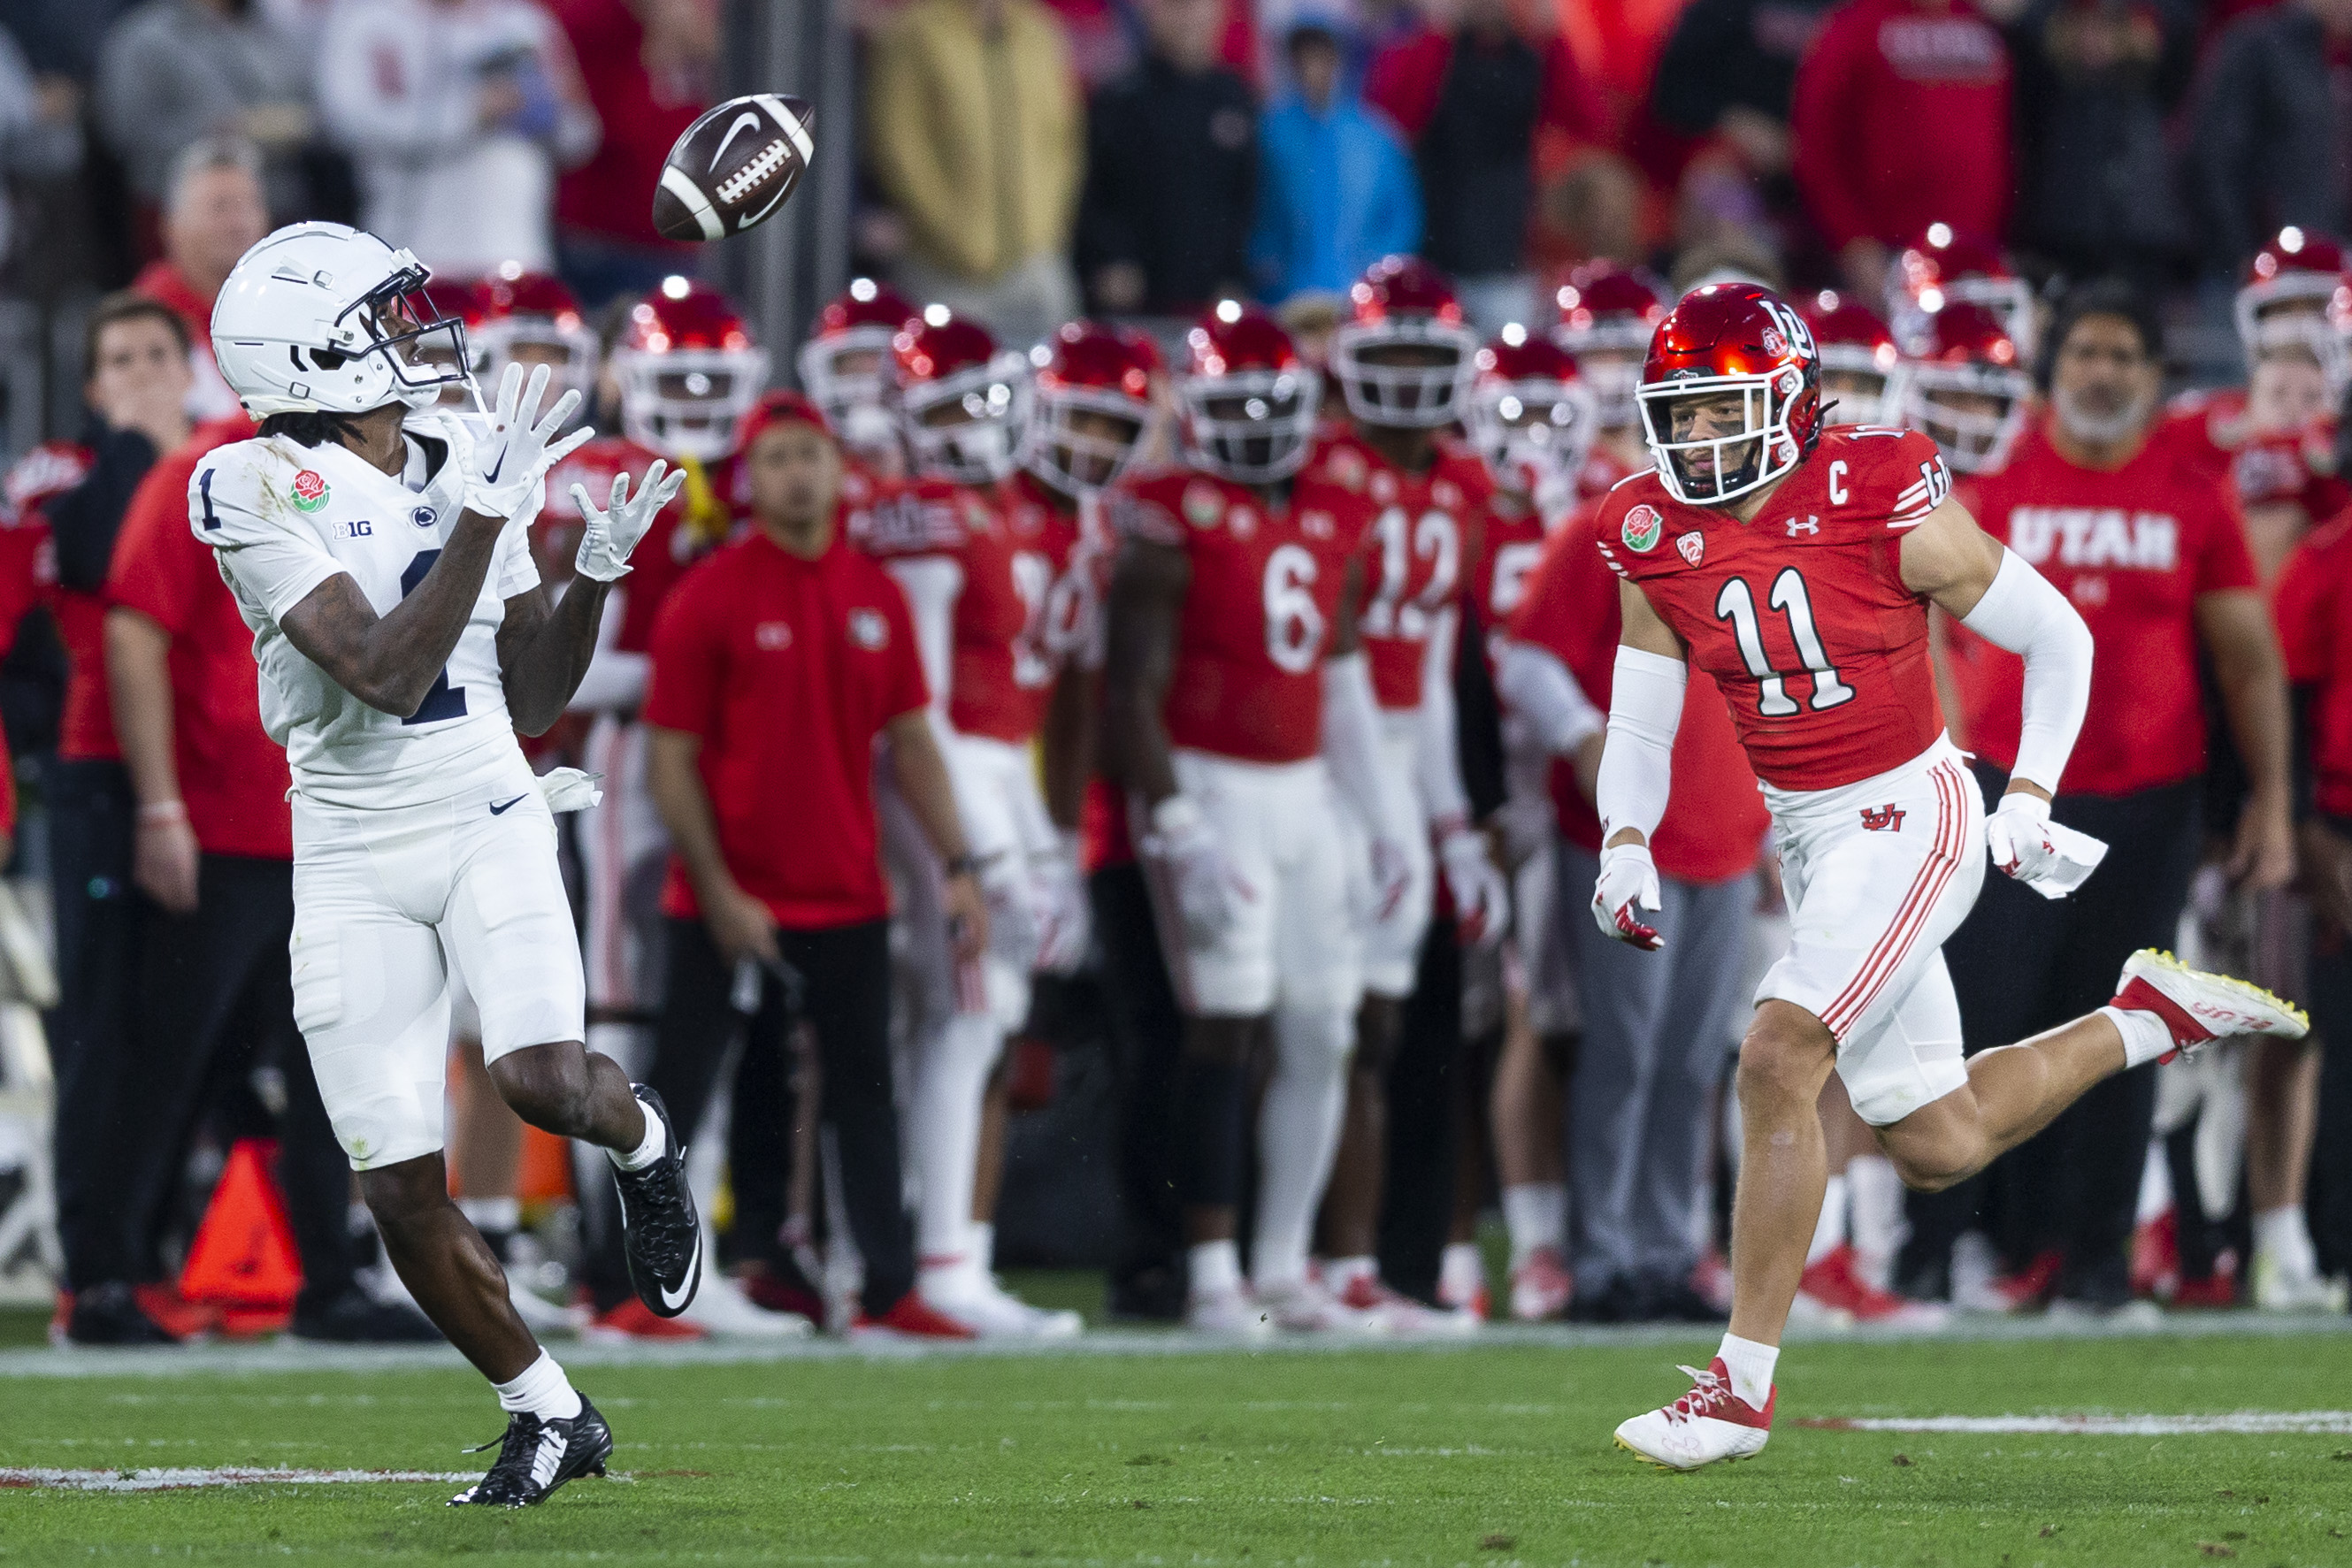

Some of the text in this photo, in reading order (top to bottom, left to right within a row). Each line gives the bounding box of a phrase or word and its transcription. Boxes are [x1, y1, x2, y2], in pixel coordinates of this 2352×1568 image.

[198, 468, 222, 532] 1
[1828, 459, 1849, 506] C
[2007, 504, 2180, 569] UTAH
[1360, 504, 1461, 641] 12
[1262, 541, 1325, 675] 6
[1715, 566, 1856, 717] 11
[530, 1426, 569, 1490] NIKE
